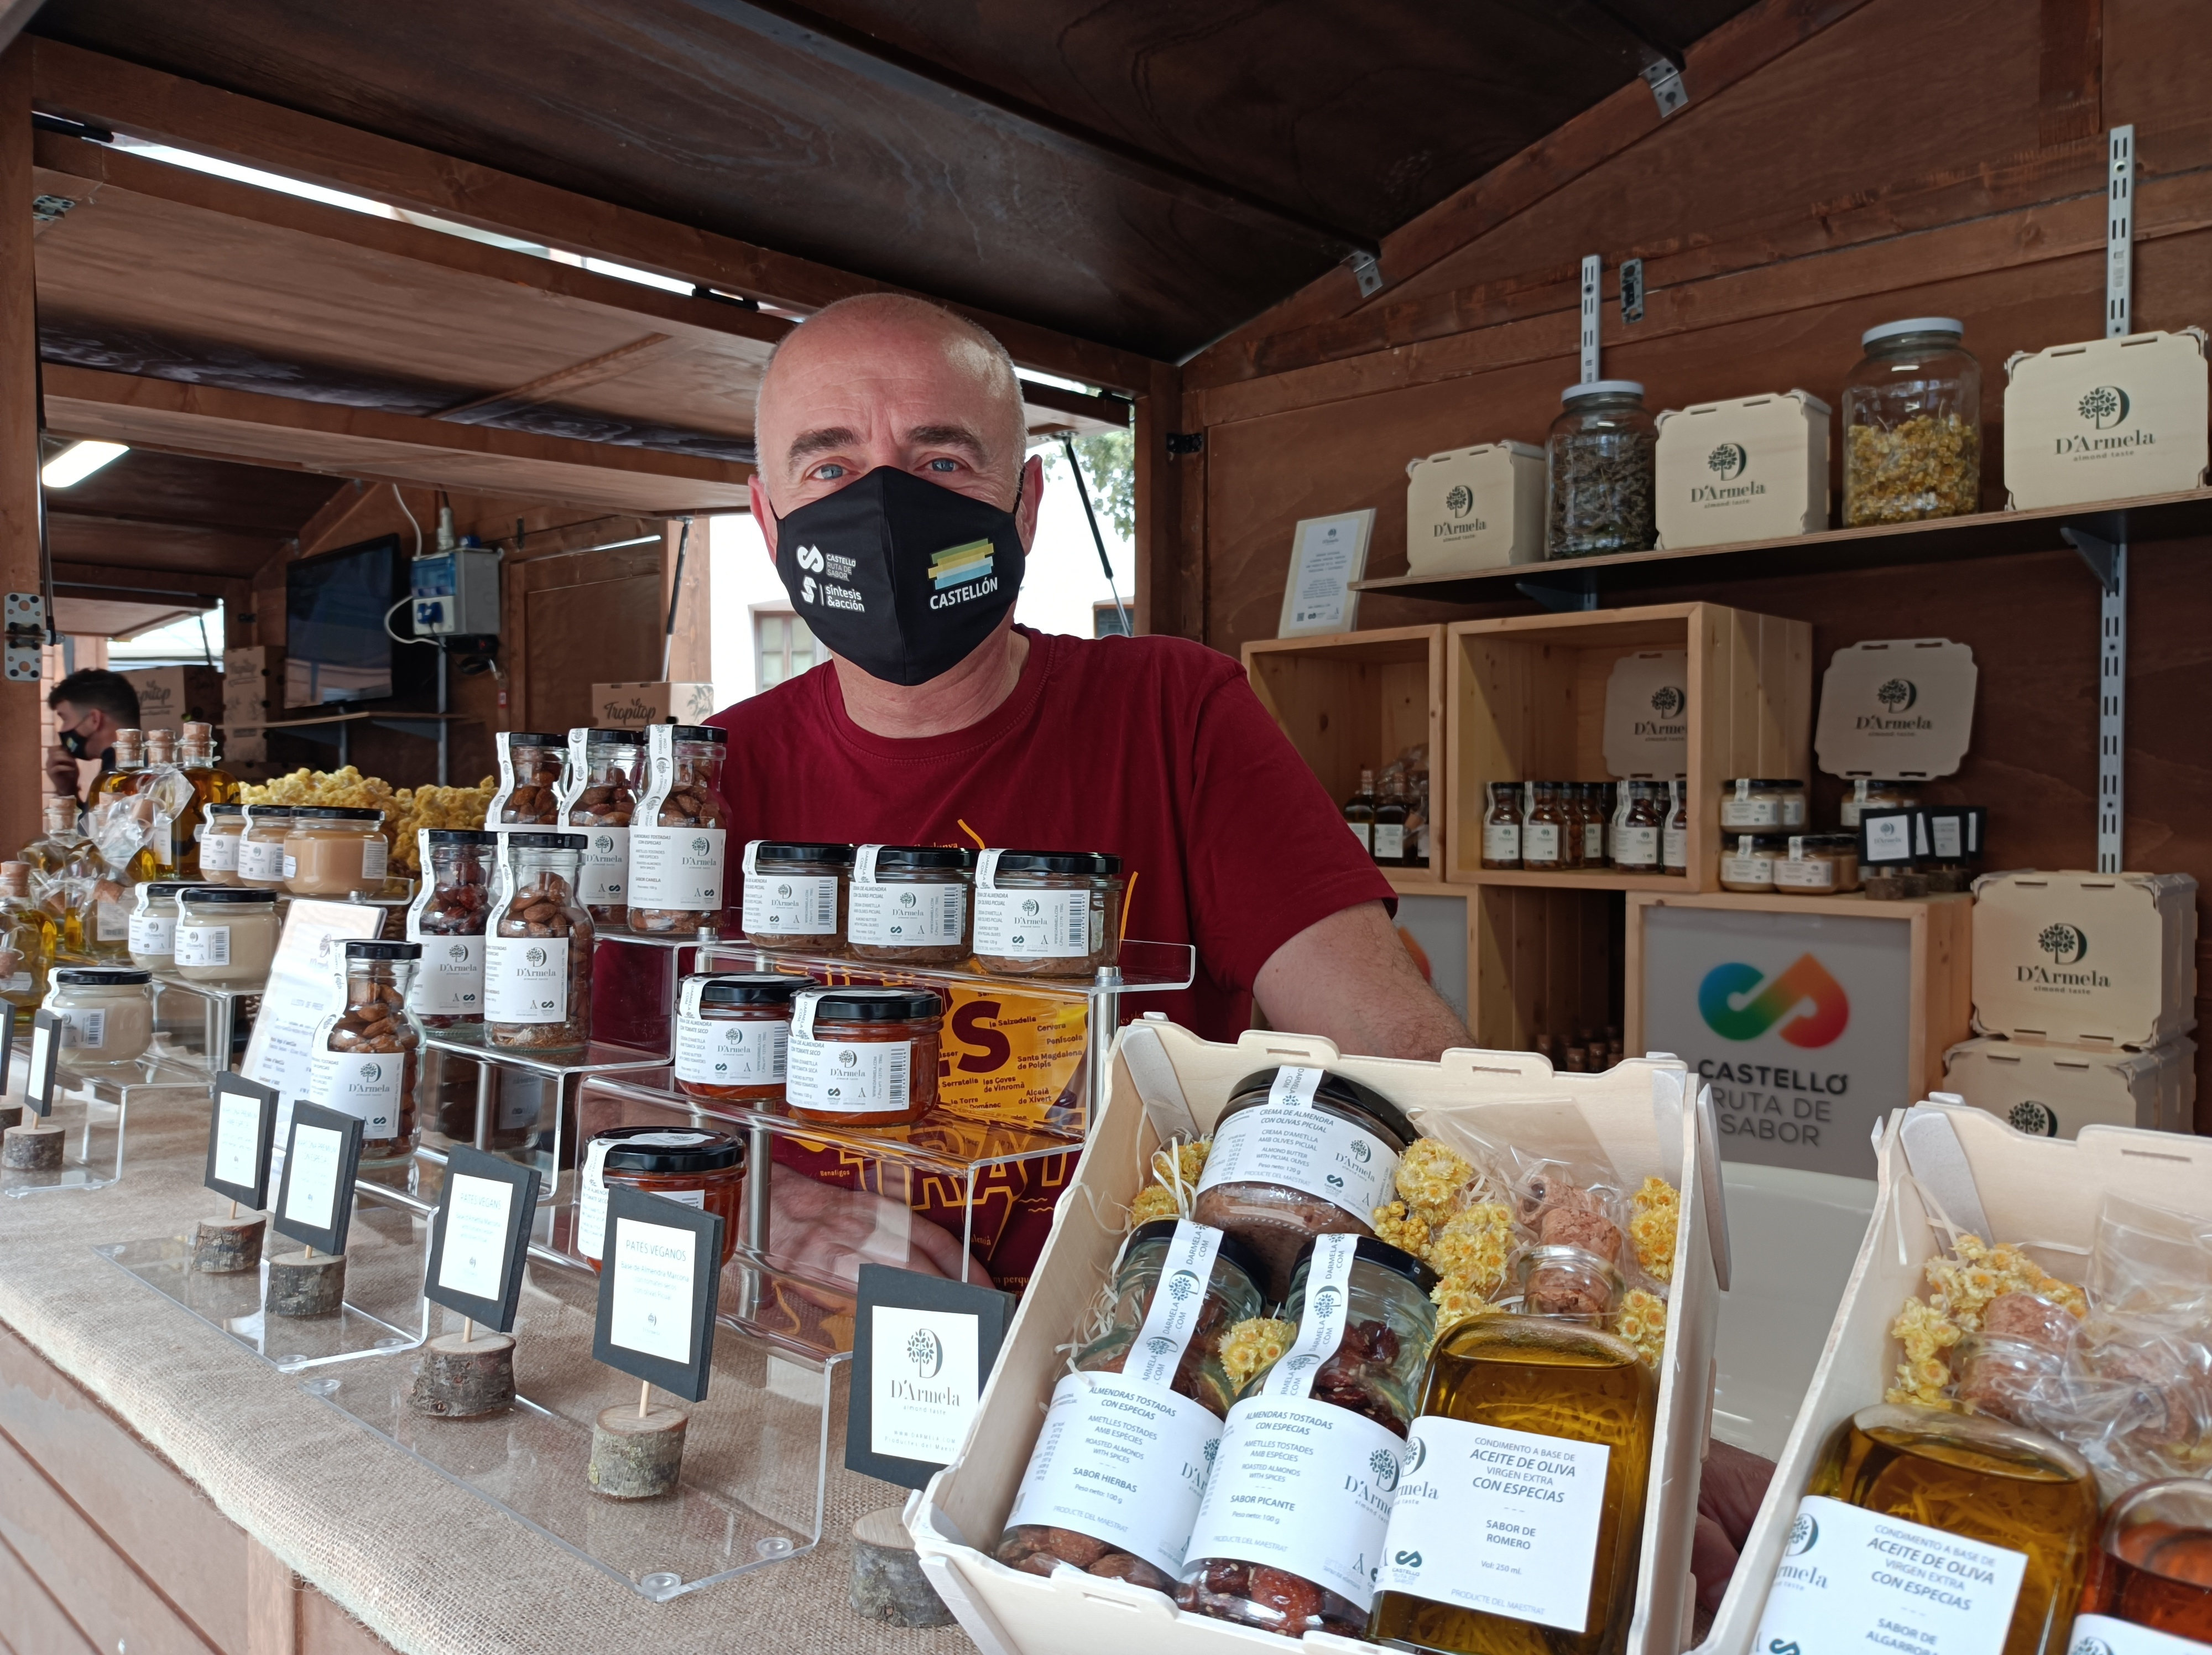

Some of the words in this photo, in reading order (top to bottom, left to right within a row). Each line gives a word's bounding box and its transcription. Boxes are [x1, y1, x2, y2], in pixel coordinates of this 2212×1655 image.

[2054, 429, 2156, 455] D'Armela
[2073, 452, 2107, 462] almond
[2111, 450, 2135, 458] taste
[1690, 481, 1766, 503] D'Armela
[1704, 501, 1729, 509] almond
[1433, 518, 1486, 538] D'Armela
[827, 562, 842, 571] RUTA
[827, 569, 848, 579] SABOR
[930, 577, 998, 610] CASTELLÓN
[828, 596, 865, 612] &acción
[604, 698, 656, 726] Tropitop
[1855, 715, 1932, 730] D'Armela
[586, 854, 623, 862] D'Armela
[682, 857, 717, 866] D'Armela
[1014, 917, 1048, 925] D'Armela
[517, 968, 556, 976] D'Armela
[2016, 965, 2111, 987] D'Armela
[998, 1016, 1036, 1027] Salzadella
[1037, 1023, 1066, 1032] Cervera
[1041, 1049, 1083, 1061] Magdalena
[830, 1069, 866, 1077] D'Armela
[995, 1076, 1016, 1084] Coves
[1290, 1068, 1305, 1094] DARMELA
[348, 1084, 390, 1092] D'Armela
[942, 1078, 979, 1088] Serratella
[1710, 1086, 1782, 1117] RUTA
[1793, 1097, 1831, 1122] DE
[1276, 1118, 1301, 1128] OLIVAS
[1302, 1120, 1327, 1133] PICUAL
[1295, 1111, 1334, 1126] ALMENDRA
[1283, 1131, 1318, 1143] D'AMETLLA
[1720, 1113, 1820, 1147] SABOR
[1261, 1147, 1285, 1155] ALMOND
[1286, 1150, 1308, 1159] BUTTER
[1272, 1138, 1293, 1147] OLIVES
[1295, 1141, 1317, 1151] PICUAL
[1272, 1155, 1290, 1163] PICUAL
[1290, 1157, 1310, 1168] OLIVES
[1335, 1152, 1376, 1183] D'Armela
[820, 1169, 850, 1178] Benafigos
[479, 1197, 502, 1210] VEGANS
[626, 1240, 648, 1254] PATÉS
[650, 1245, 686, 1262] VEGANOS
[1186, 1231, 1202, 1265] DARMELA
[1325, 1244, 1338, 1279] DARMELA
[621, 1261, 632, 1270] Base
[641, 1265, 666, 1277] Almendra
[667, 1271, 689, 1282] Marcona
[644, 1278, 663, 1287] tomates
[664, 1282, 677, 1290] secos
[643, 1288, 656, 1297] olivas
[658, 1292, 671, 1300] Picual
[1162, 1302, 1180, 1335] DARMELA
[1309, 1320, 1326, 1352] DARMELA
[891, 1379, 960, 1407] D'Armela
[1089, 1386, 1135, 1401] ALMENDRAS
[1136, 1394, 1177, 1417] TOSTADAS
[903, 1405, 927, 1413] almond
[1101, 1399, 1119, 1409] CON
[1119, 1402, 1156, 1420] ESPECIAS
[1088, 1415, 1122, 1428] AMETLLES
[1123, 1421, 1158, 1440] TOSTADES
[1245, 1411, 1288, 1420] ALMENDRAS
[1289, 1412, 1334, 1430] TOSTADAS
[1255, 1422, 1272, 1430] CON
[1272, 1423, 1311, 1435] ESPECIAS
[1086, 1437, 1112, 1450] ROASTED
[1113, 1444, 1144, 1460] ALMONDS
[1093, 1448, 1109, 1458] WITH
[1109, 1452, 1130, 1464] SPICES
[1244, 1440, 1275, 1449] AMETLLES
[1277, 1441, 1314, 1455] TOSTADES
[1474, 1437, 1531, 1454] CONDIMENTO
[1540, 1449, 1562, 1459] BASE
[1563, 1453, 1575, 1461] DE
[1268, 1465, 1301, 1477] ALMONDS
[1469, 1448, 1514, 1466] ACEITE
[1516, 1457, 1535, 1470] DE
[1537, 1460, 1577, 1477] OLIVA
[1073, 1467, 1100, 1481] SABOR
[1105, 1473, 1138, 1493] HIERBAS
[1264, 1474, 1286, 1482] SPICES
[1486, 1466, 1521, 1480] VIRGEN
[1523, 1472, 1553, 1486] EXTRA
[1472, 1476, 1503, 1492] CON
[1503, 1482, 1566, 1503] ESPECIAS
[1230, 1495, 1256, 1505] SABOR
[1258, 1497, 1296, 1512] PICANTE
[1486, 1519, 1521, 1534] SABOR
[1522, 1526, 1536, 1537] DE
[1486, 1533, 1531, 1550] ROMERO
[1495, 1563, 1510, 1573] 250
[1866, 1537, 1922, 1562] ACEITE
[1922, 1553, 1943, 1569] DE
[1946, 1559, 1996, 1585] OLIVA
[1885, 1558, 1928, 1579] VIRGEN
[1927, 1571, 1966, 1591] EXTRA
[1870, 1570, 1903, 1590] CON
[1904, 1580, 1974, 1612] ESPECIAS
[1451, 1588, 1490, 1604] PRODUCTE
[1491, 1598, 1506, 1607] DEL
[1507, 1601, 1546, 1616] MAESTRAT
[1876, 1617, 1919, 1640] SABOR
[1919, 1630, 1939, 1647] DE
